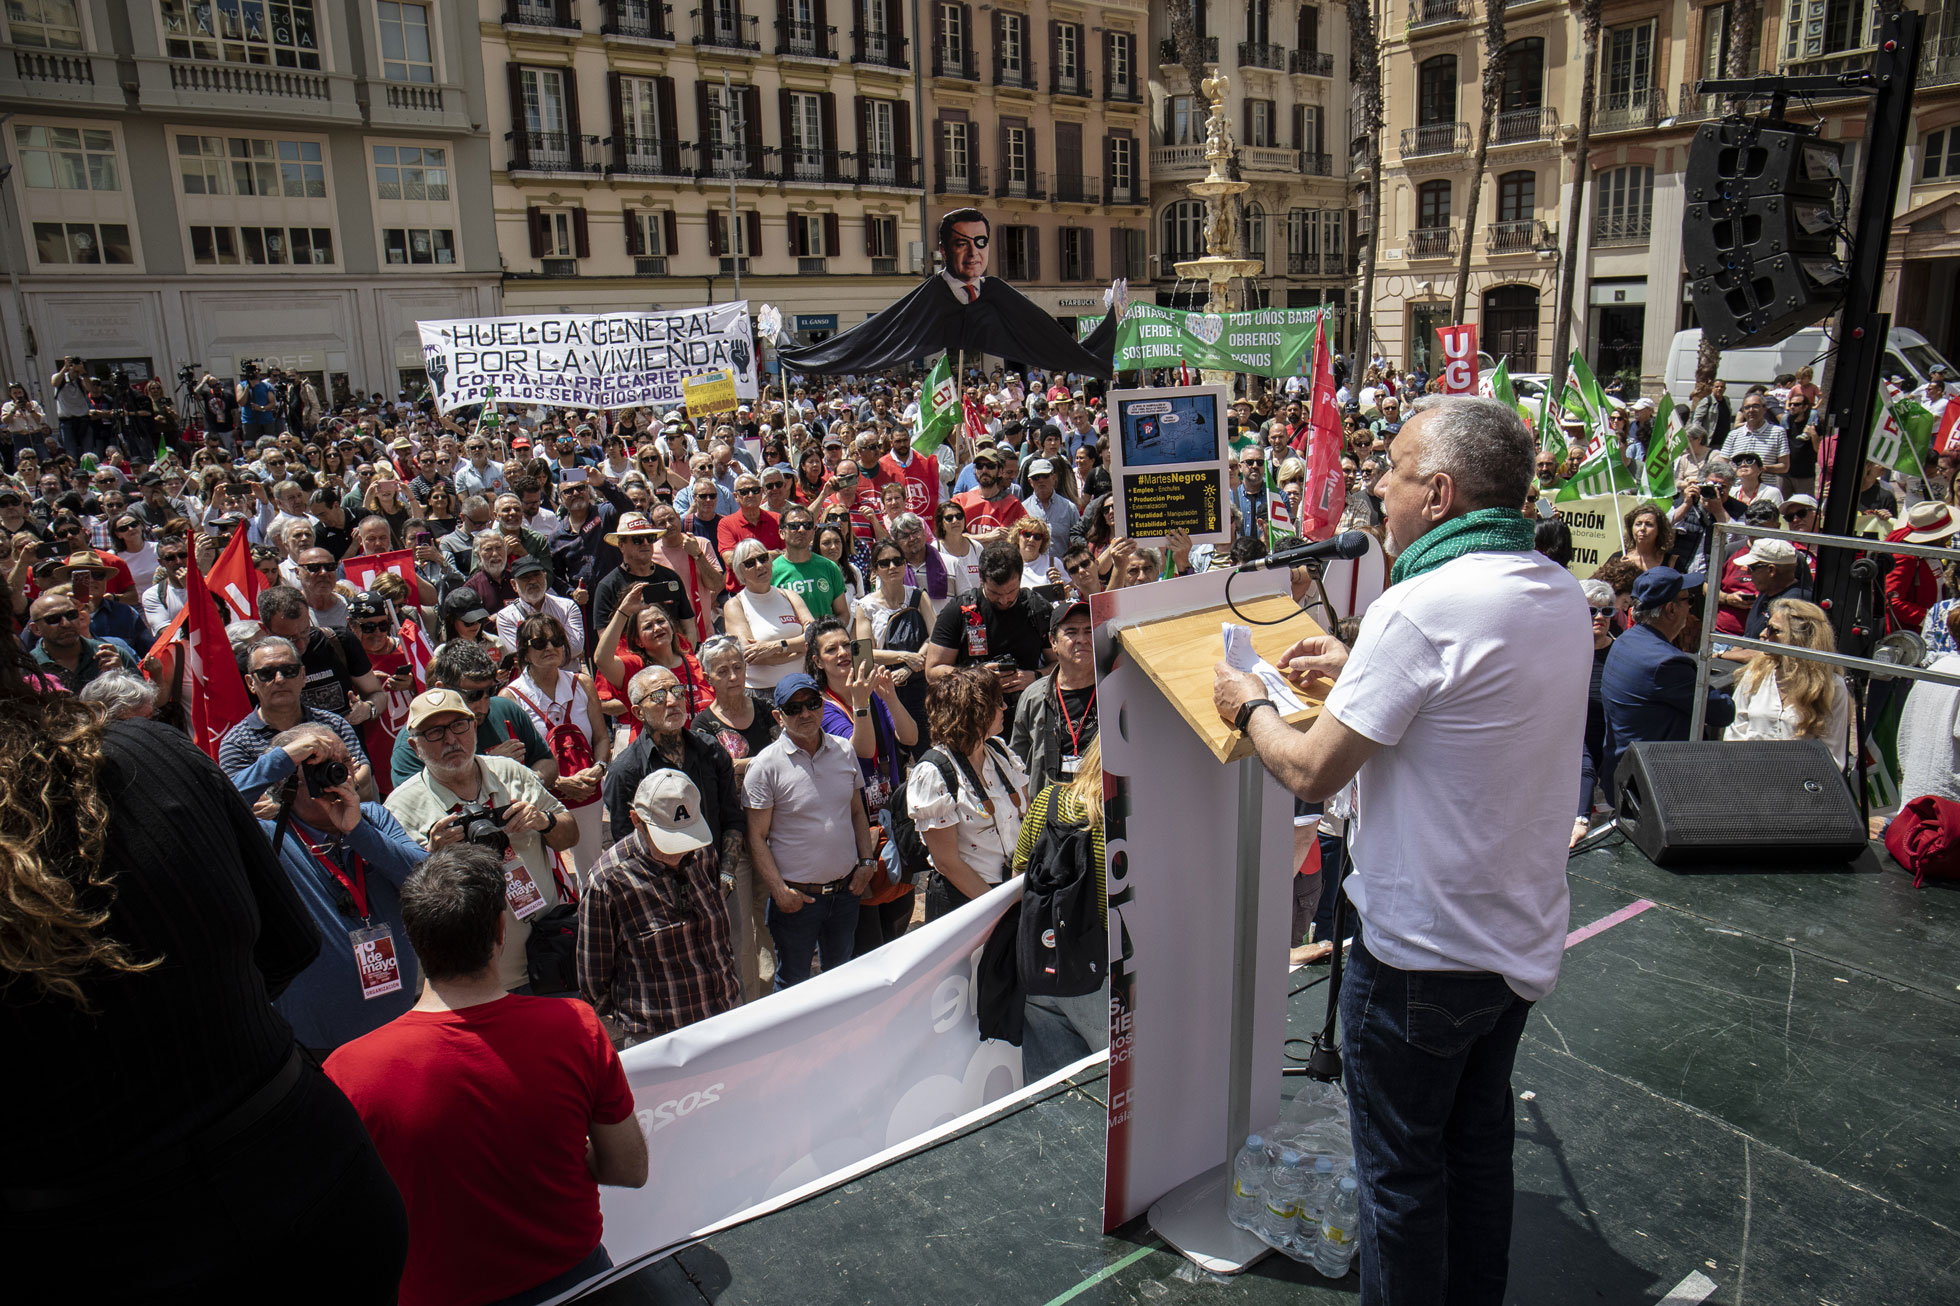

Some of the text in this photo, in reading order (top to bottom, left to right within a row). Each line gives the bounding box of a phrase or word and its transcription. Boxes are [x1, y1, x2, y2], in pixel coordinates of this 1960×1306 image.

[166, 15, 313, 46] MÁLAGA
[1229, 313, 1252, 326] POR
[1255, 311, 1284, 325] UNOS
[453, 313, 724, 347] HUELGA GENERAL
[1079, 319, 1103, 334] MA
[1139, 325, 1182, 338] VERDE Y
[1229, 332, 1281, 346] OBREROS
[1122, 344, 1183, 360] SOSTENIBLE
[455, 350, 527, 375] POR
[537, 349, 582, 374] LA
[540, 373, 567, 388] LA
[451, 391, 460, 404] Y
[468, 387, 502, 400] POR
[511, 386, 545, 399] LOS
[550, 388, 638, 406] SERVICIOS
[1138, 473, 1207, 485] #MartesNegros
[1133, 494, 1165, 503] Producción
[1166, 494, 1185, 502] Propia
[1134, 511, 1164, 519] Pluralidad
[582, 519, 597, 534] UGT
[1135, 519, 1167, 528] Estabilidad
[1136, 529, 1163, 537] SERVICIO
[673, 804, 691, 822] A
[507, 881, 537, 900] mayo
[508, 880, 523, 891] de
[367, 951, 383, 964] de
[362, 957, 397, 975] mayo
[365, 981, 400, 997] ORGANIZACIÓN
